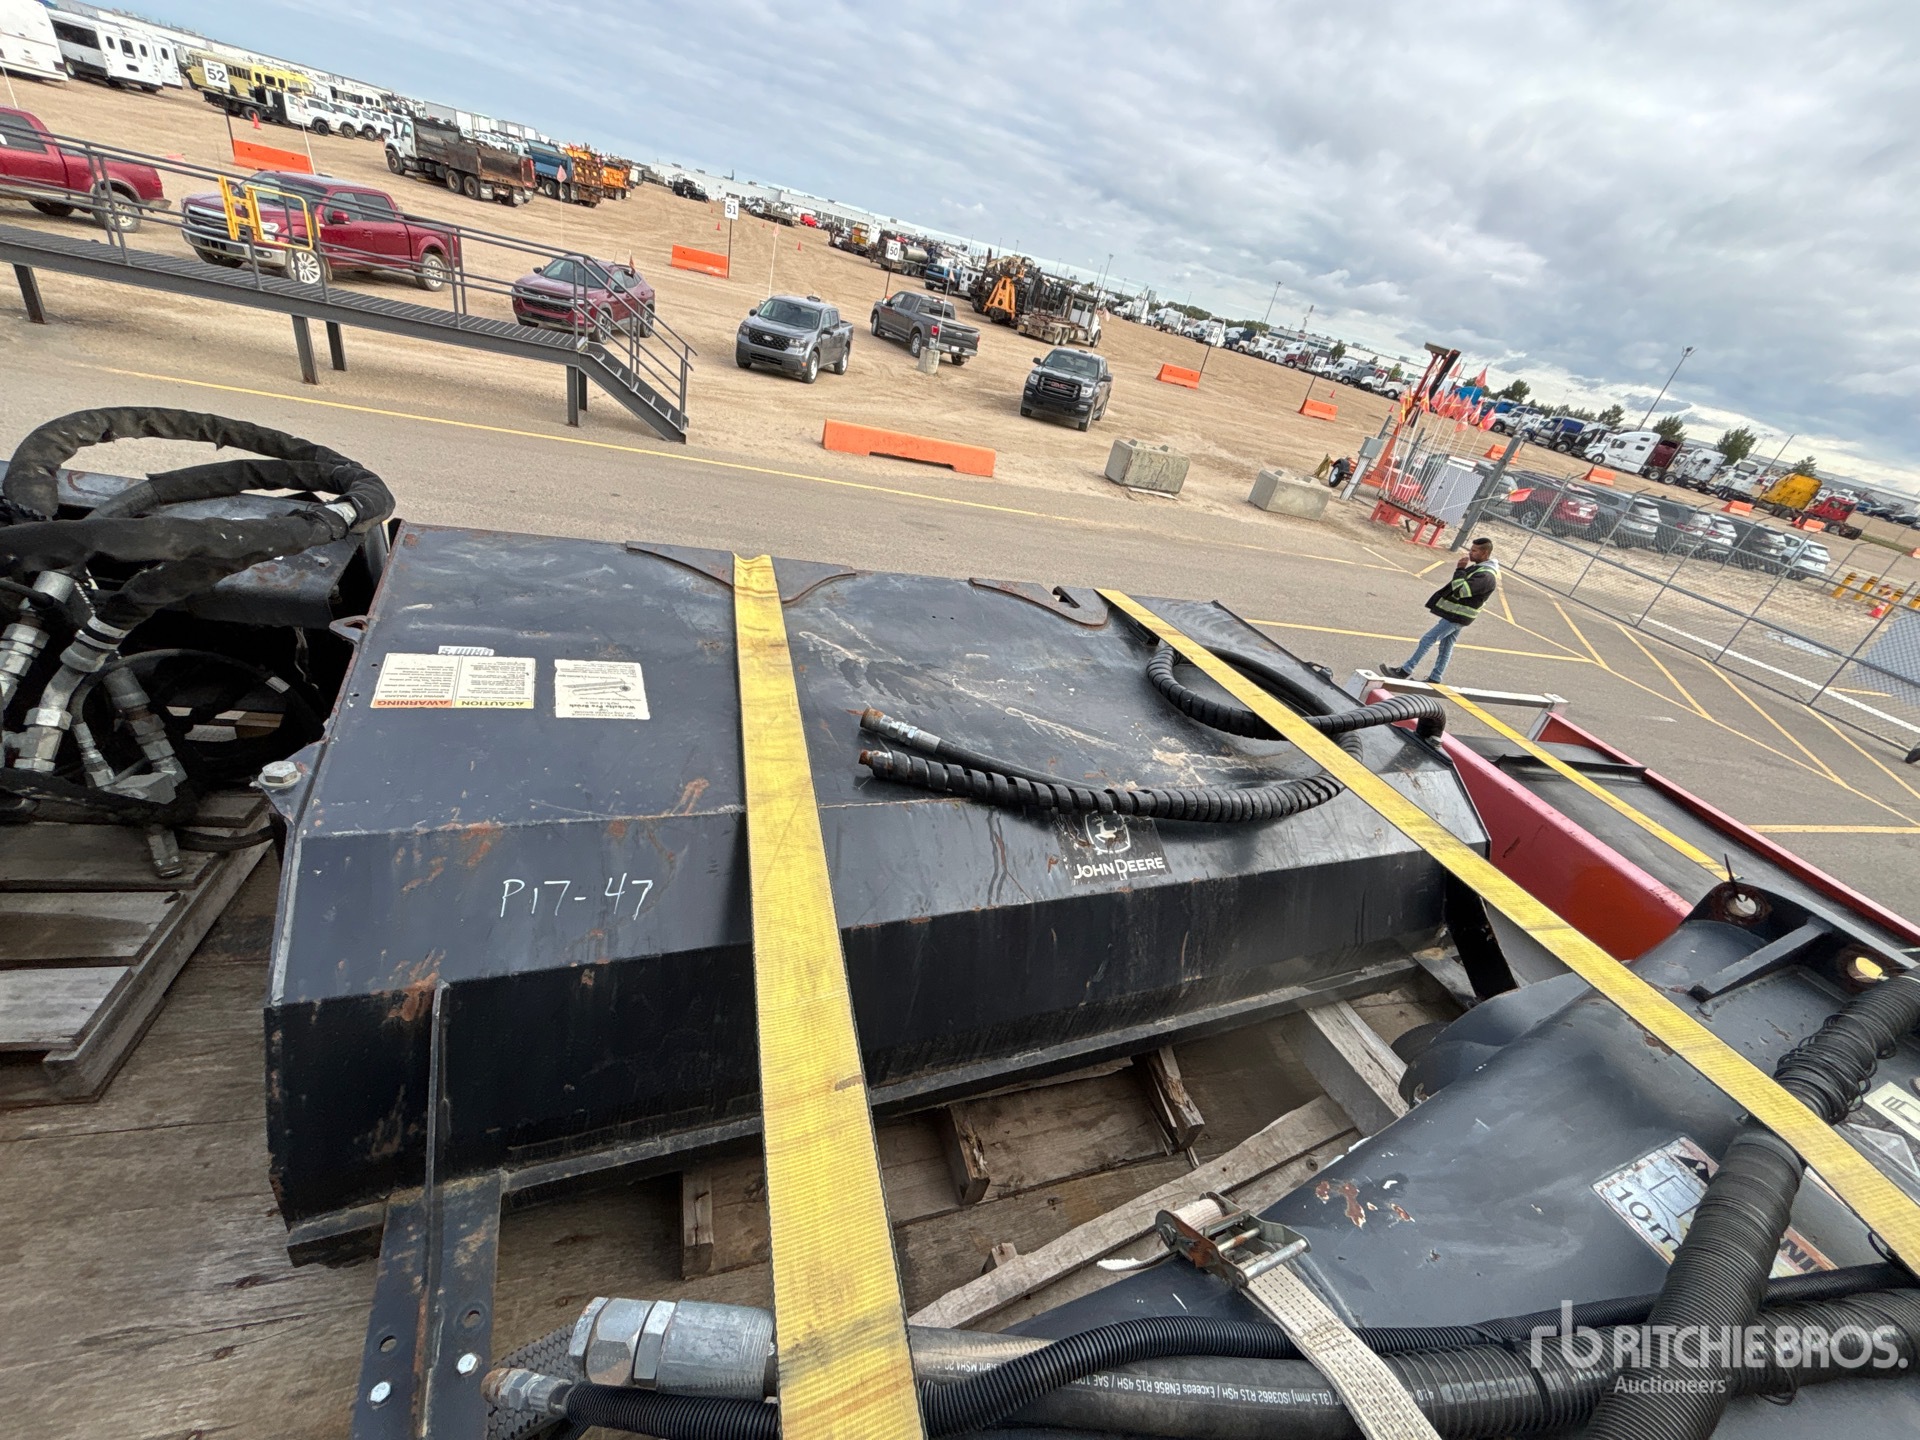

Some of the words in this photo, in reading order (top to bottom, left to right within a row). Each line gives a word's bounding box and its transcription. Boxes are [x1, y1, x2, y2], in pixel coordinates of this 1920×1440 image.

[207, 68, 227, 83] 52
[726, 204, 737, 215] 51
[889, 246, 898, 256] 50
[1074, 862, 1115, 879] JOHN
[1114, 857, 1165, 874] DEERE
[500, 872, 653, 920] P17-47
[1093, 1374, 1109, 1388] SAE
[1136, 1379, 1152, 1392] R15
[1154, 1381, 1181, 1395] EN856
[1182, 1384, 1215, 1398] Exceeds
[1241, 1388, 1256, 1402] R15
